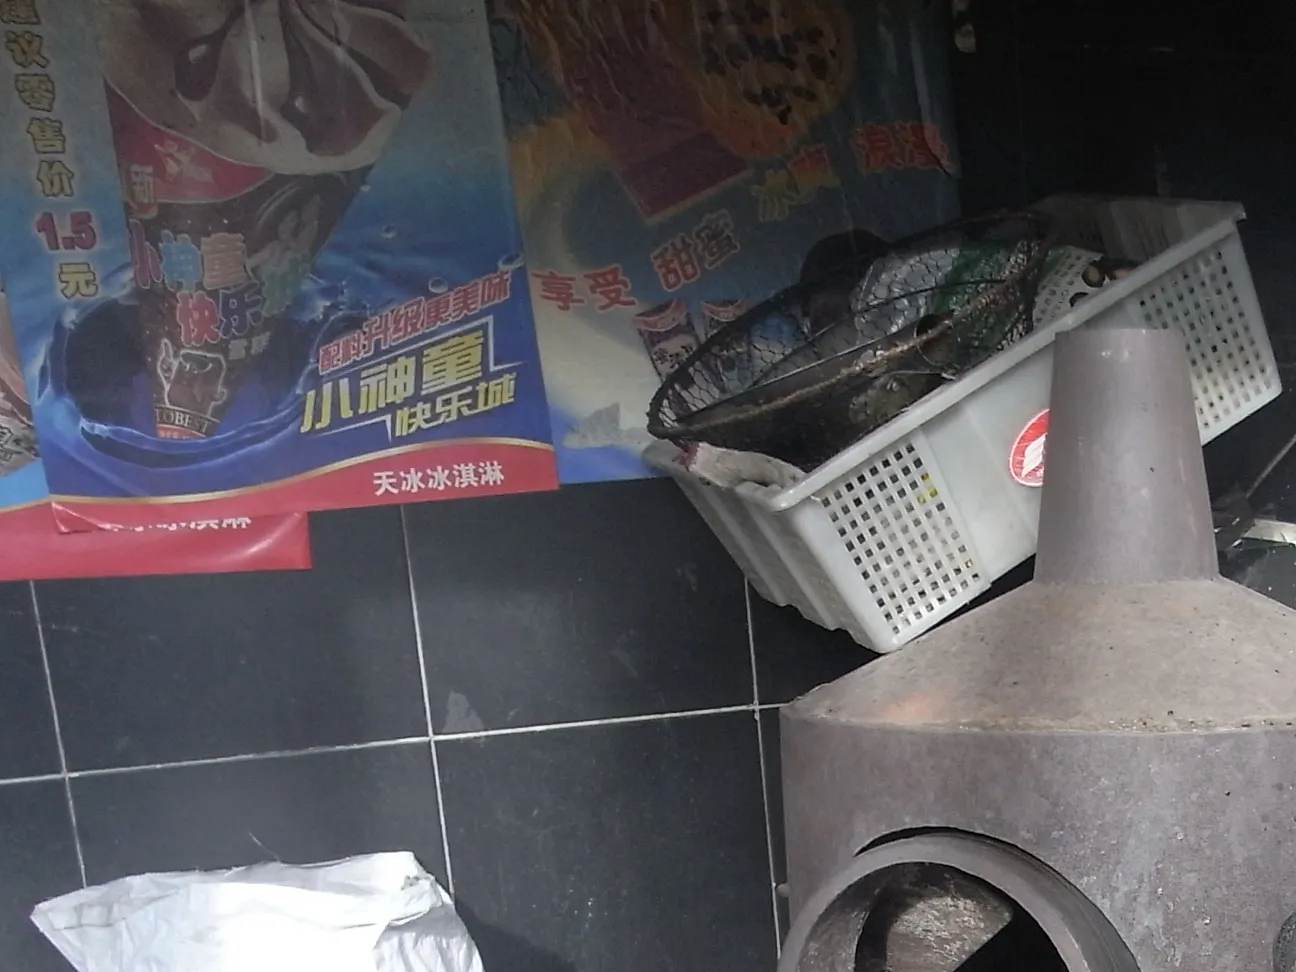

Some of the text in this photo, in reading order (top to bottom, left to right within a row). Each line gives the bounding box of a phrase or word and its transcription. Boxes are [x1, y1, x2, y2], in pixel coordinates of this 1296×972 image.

[36, 211, 97, 252] 1.5
[533, 209, 740, 313] 享受 甜蜜
[58, 262, 99, 300] 元
[319, 271, 513, 375] 配料升级更美味
[300, 331, 485, 433] 小神童
[395, 372, 517, 438] 快乐城
[373, 461, 505, 497] 天冰冰淇淋
